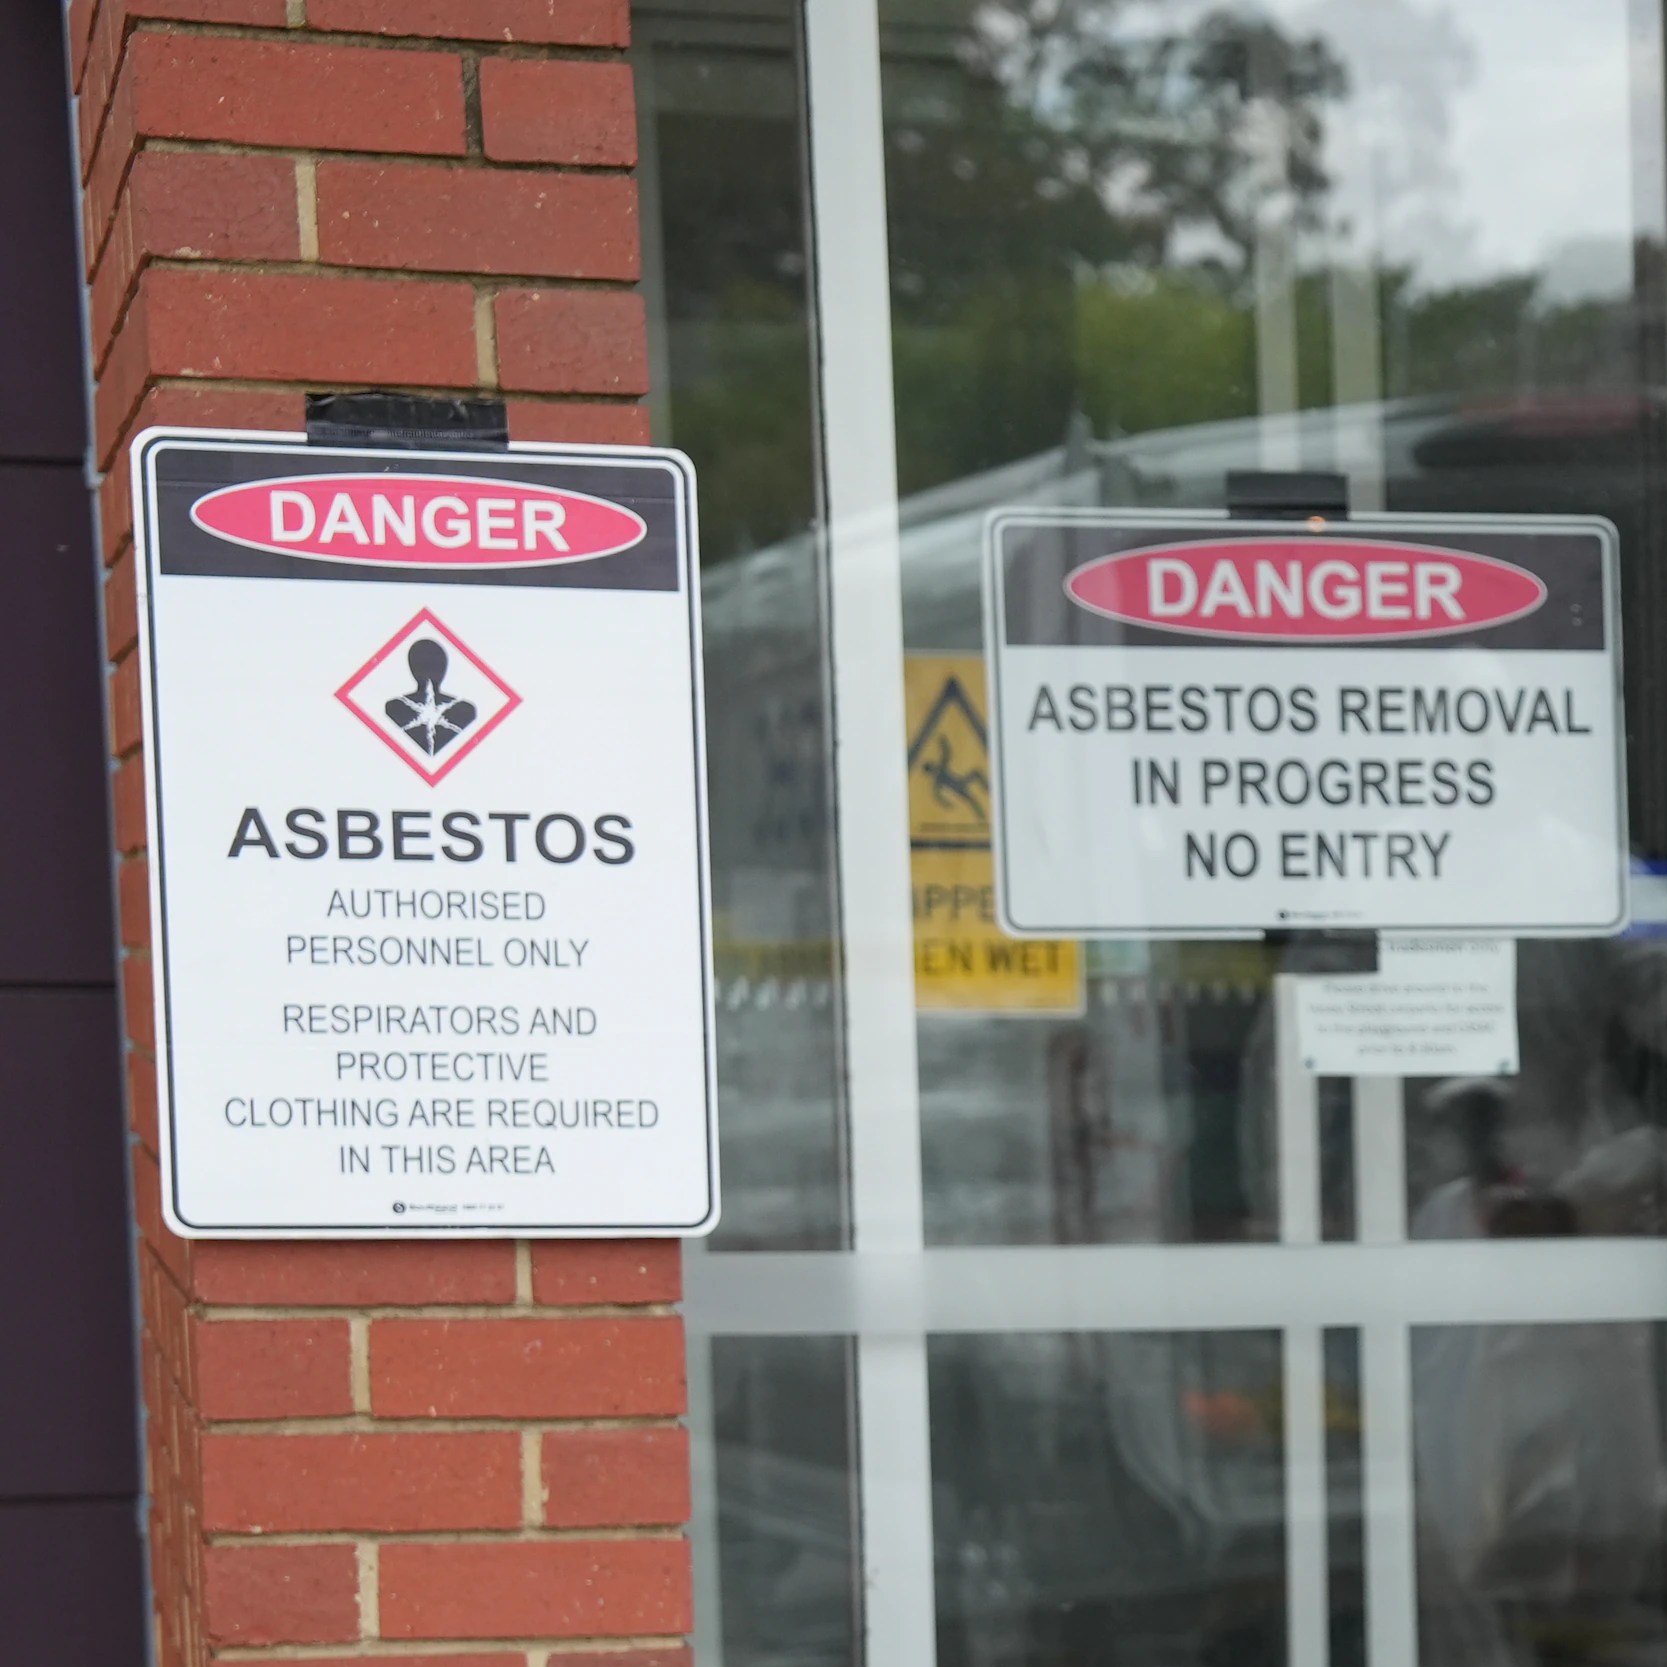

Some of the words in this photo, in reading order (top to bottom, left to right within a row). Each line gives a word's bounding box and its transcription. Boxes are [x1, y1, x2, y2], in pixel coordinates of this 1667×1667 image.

[270, 491, 569, 552] DANGER
[1147, 561, 1465, 620] DANGER
[1028, 685, 1318, 734] ASBESTOS
[1339, 688, 1592, 734] REMOVAL
[1133, 759, 1180, 805] IN
[1202, 760, 1494, 806] PROGRESS
[227, 807, 635, 865] ASBESTOS
[1185, 832, 1259, 879] NO
[1280, 832, 1450, 879] ENTRY
[326, 889, 545, 922] AUTHORISED
[287, 935, 493, 967] PERSONNEL
[503, 938, 589, 968] ONLY
[982, 938, 1060, 976] WET
[283, 1004, 521, 1035] RESPIRATORS
[529, 1007, 598, 1037] AND
[336, 1052, 548, 1081] PROTECTIVE
[224, 1098, 399, 1128] CLOTHING
[408, 1099, 475, 1127] ARE
[487, 1100, 659, 1129] REQUIRED
[340, 1146, 371, 1173] IN
[381, 1146, 456, 1174] THIS
[465, 1146, 555, 1175] AREA
